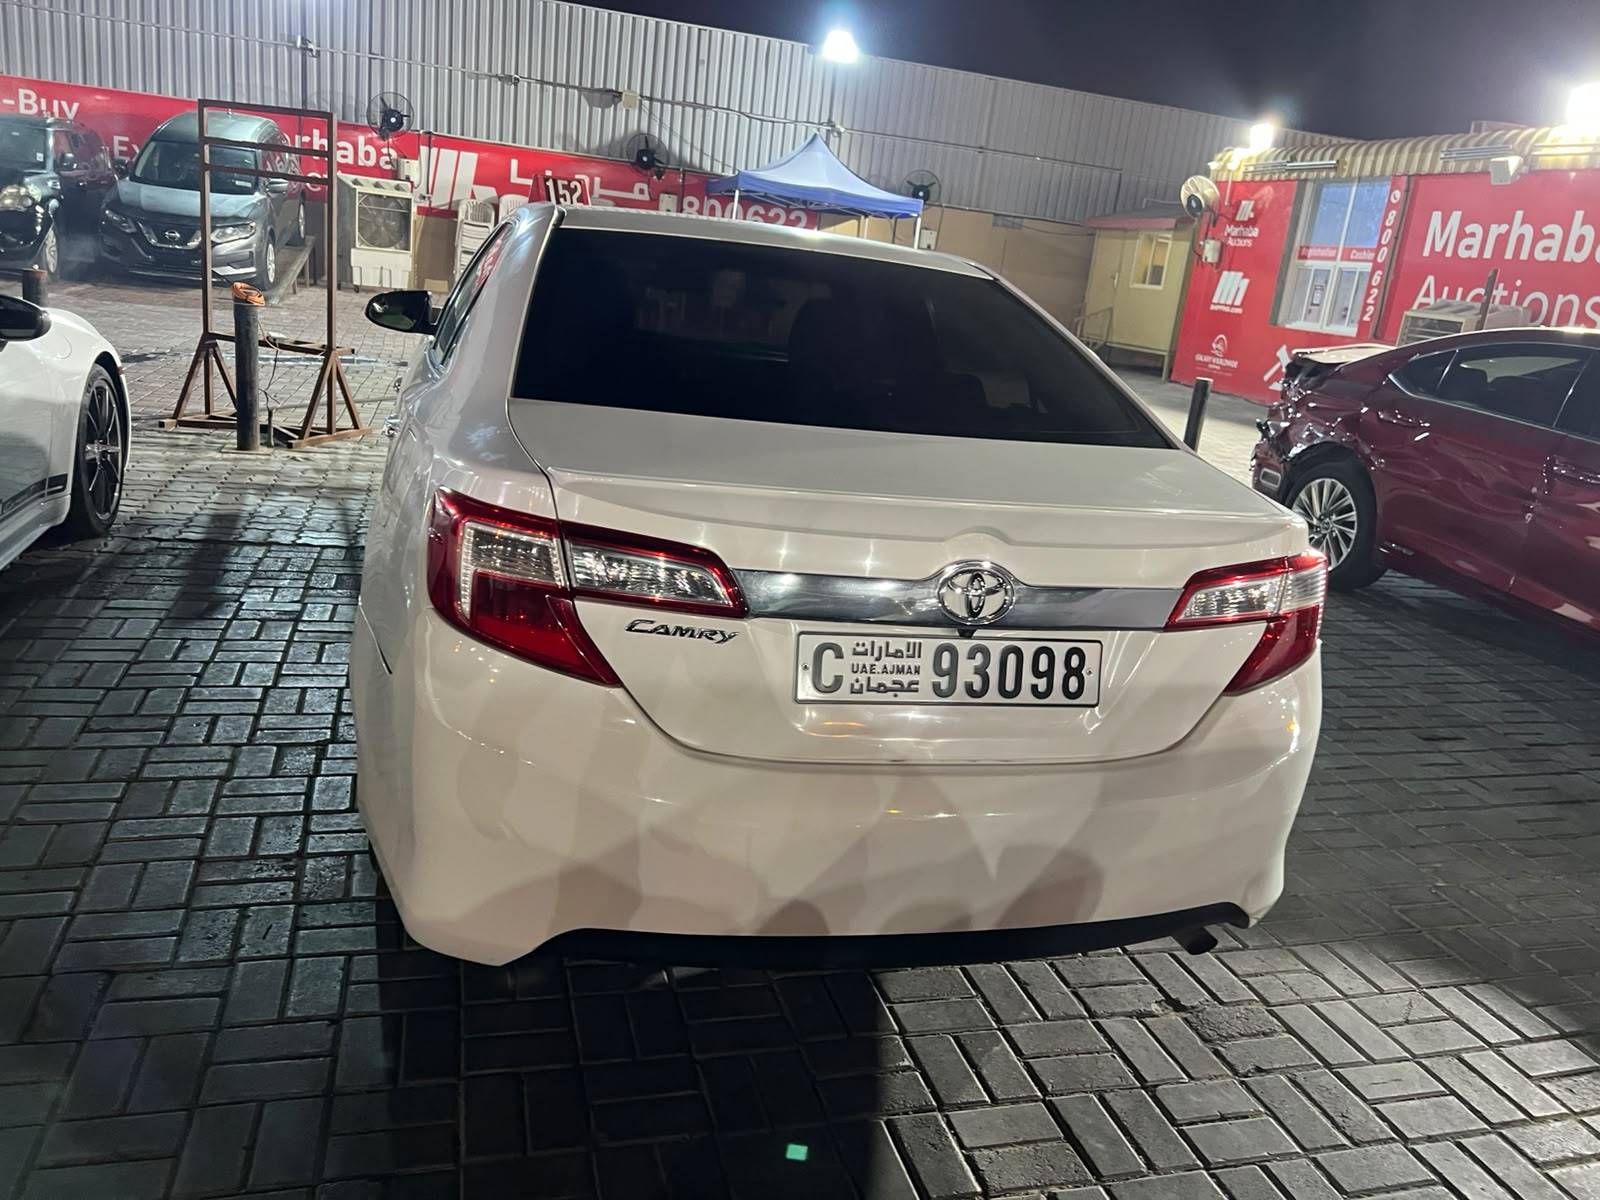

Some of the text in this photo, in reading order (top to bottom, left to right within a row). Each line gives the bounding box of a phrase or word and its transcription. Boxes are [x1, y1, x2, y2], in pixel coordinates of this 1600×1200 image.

[284, 128, 398, 170] rhaba
[546, 176, 582, 208] 152
[1422, 210, 1600, 264] Marhab
[625, 618, 740, 644] CAMRY
[812, 642, 844, 694] C
[851, 663, 921, 675] UAE.AJMAN
[932, 642, 1086, 700] 93098
[850, 676, 920, 698] عجمان
